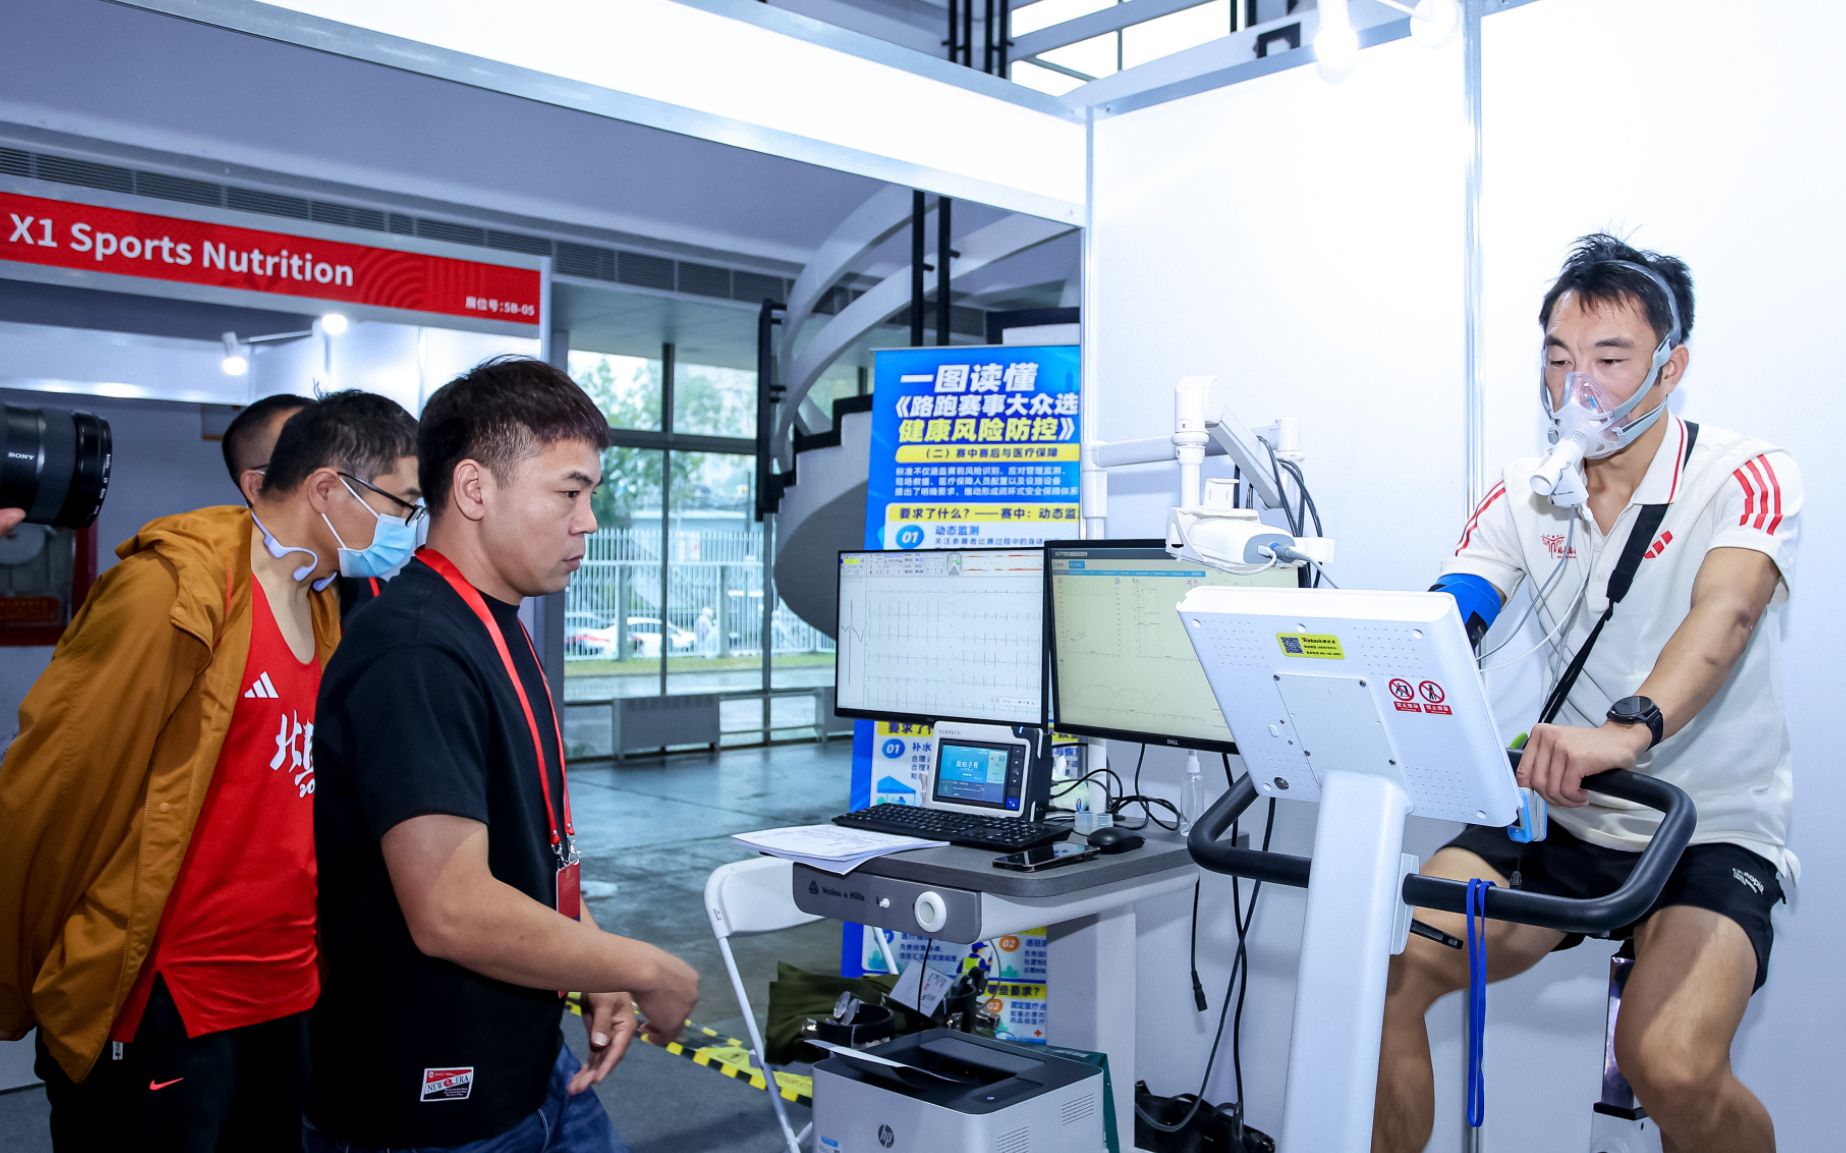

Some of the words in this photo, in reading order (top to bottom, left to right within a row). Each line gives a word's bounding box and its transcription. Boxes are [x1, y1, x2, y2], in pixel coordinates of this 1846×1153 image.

[9, 213, 57, 248] X1
[70, 222, 192, 266] Sports
[202, 241, 354, 287] Nutrition
[899, 363, 1039, 393] 一图读懂
[898, 418, 1075, 443] 健康风险防控》
[7, 451, 35, 461] SONY
[901, 531, 919, 544] 01
[935, 525, 979, 536] 动态监测
[886, 743, 901, 754] 01
[1002, 939, 1016, 948] 02
[427, 1082, 442, 1093] NEW
[455, 1075, 469, 1084] ERA
[879, 1124, 893, 1148] hp
